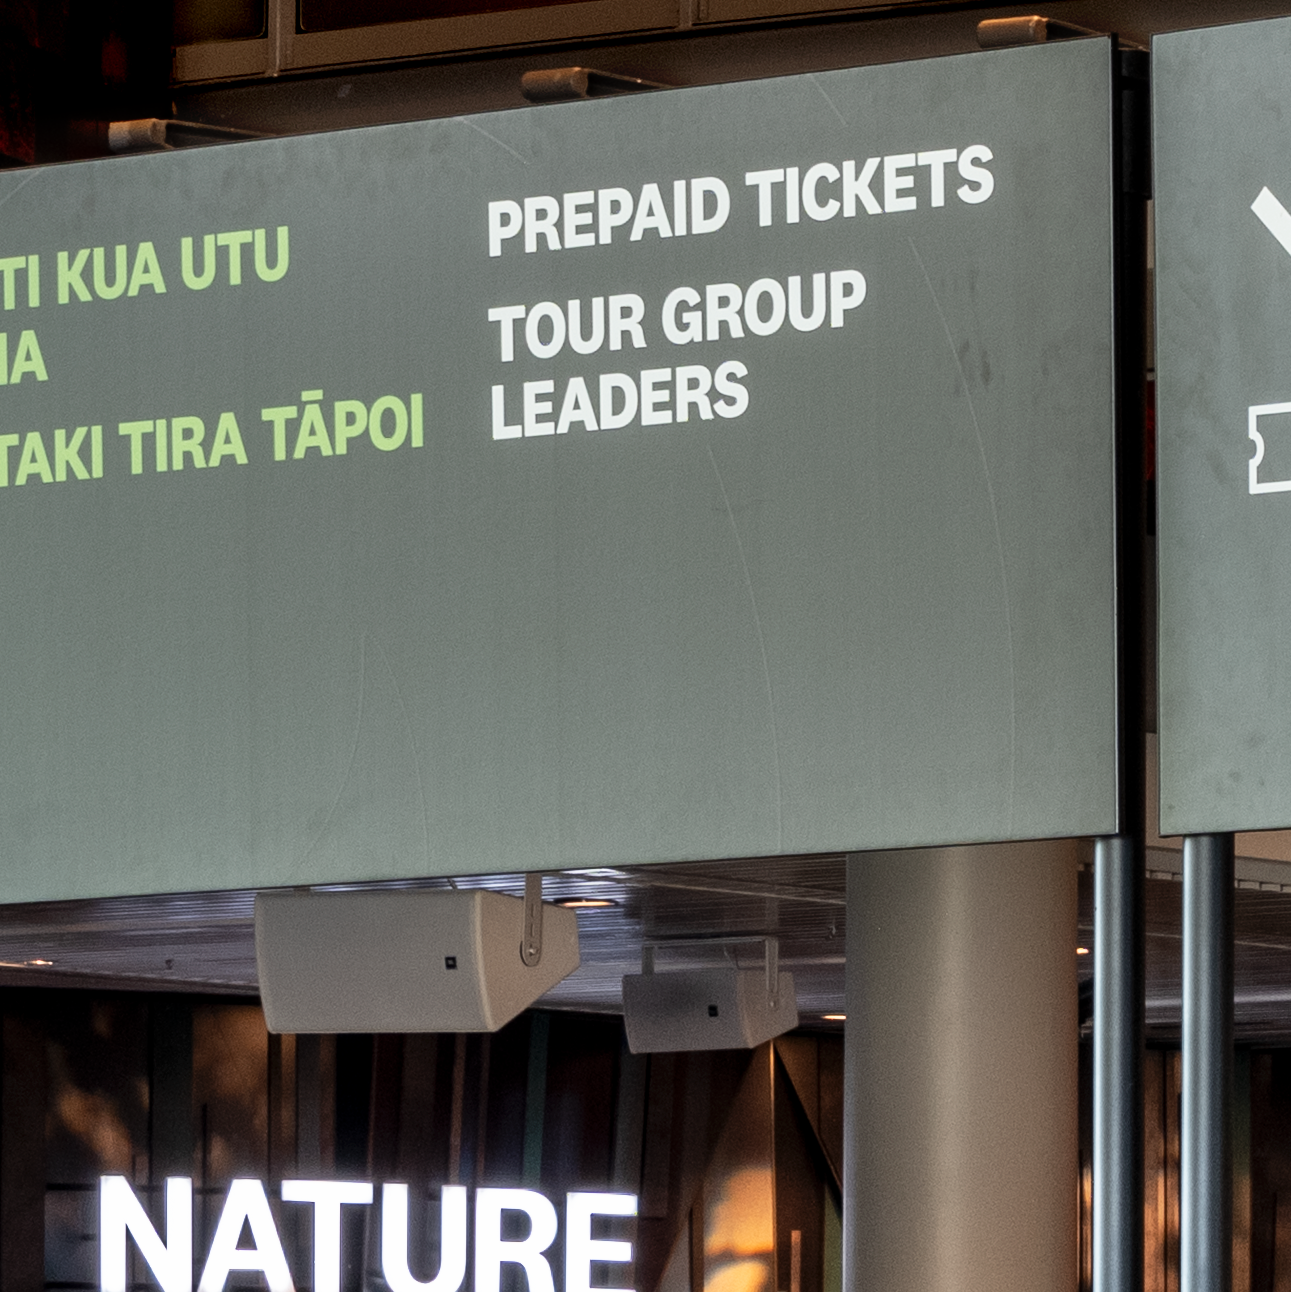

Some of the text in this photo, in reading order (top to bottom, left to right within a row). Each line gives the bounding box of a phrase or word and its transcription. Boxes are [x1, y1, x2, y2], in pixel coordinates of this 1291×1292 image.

[488, 144, 995, 258] PREPAID TICKETS
[57, 241, 167, 305] KUA
[181, 225, 290, 291] UTU
[487, 269, 867, 363] TOUR GROUP
[118, 411, 249, 475] TIRA
[261, 389, 424, 462] TĀPOI
[491, 360, 749, 441] LEADERS
